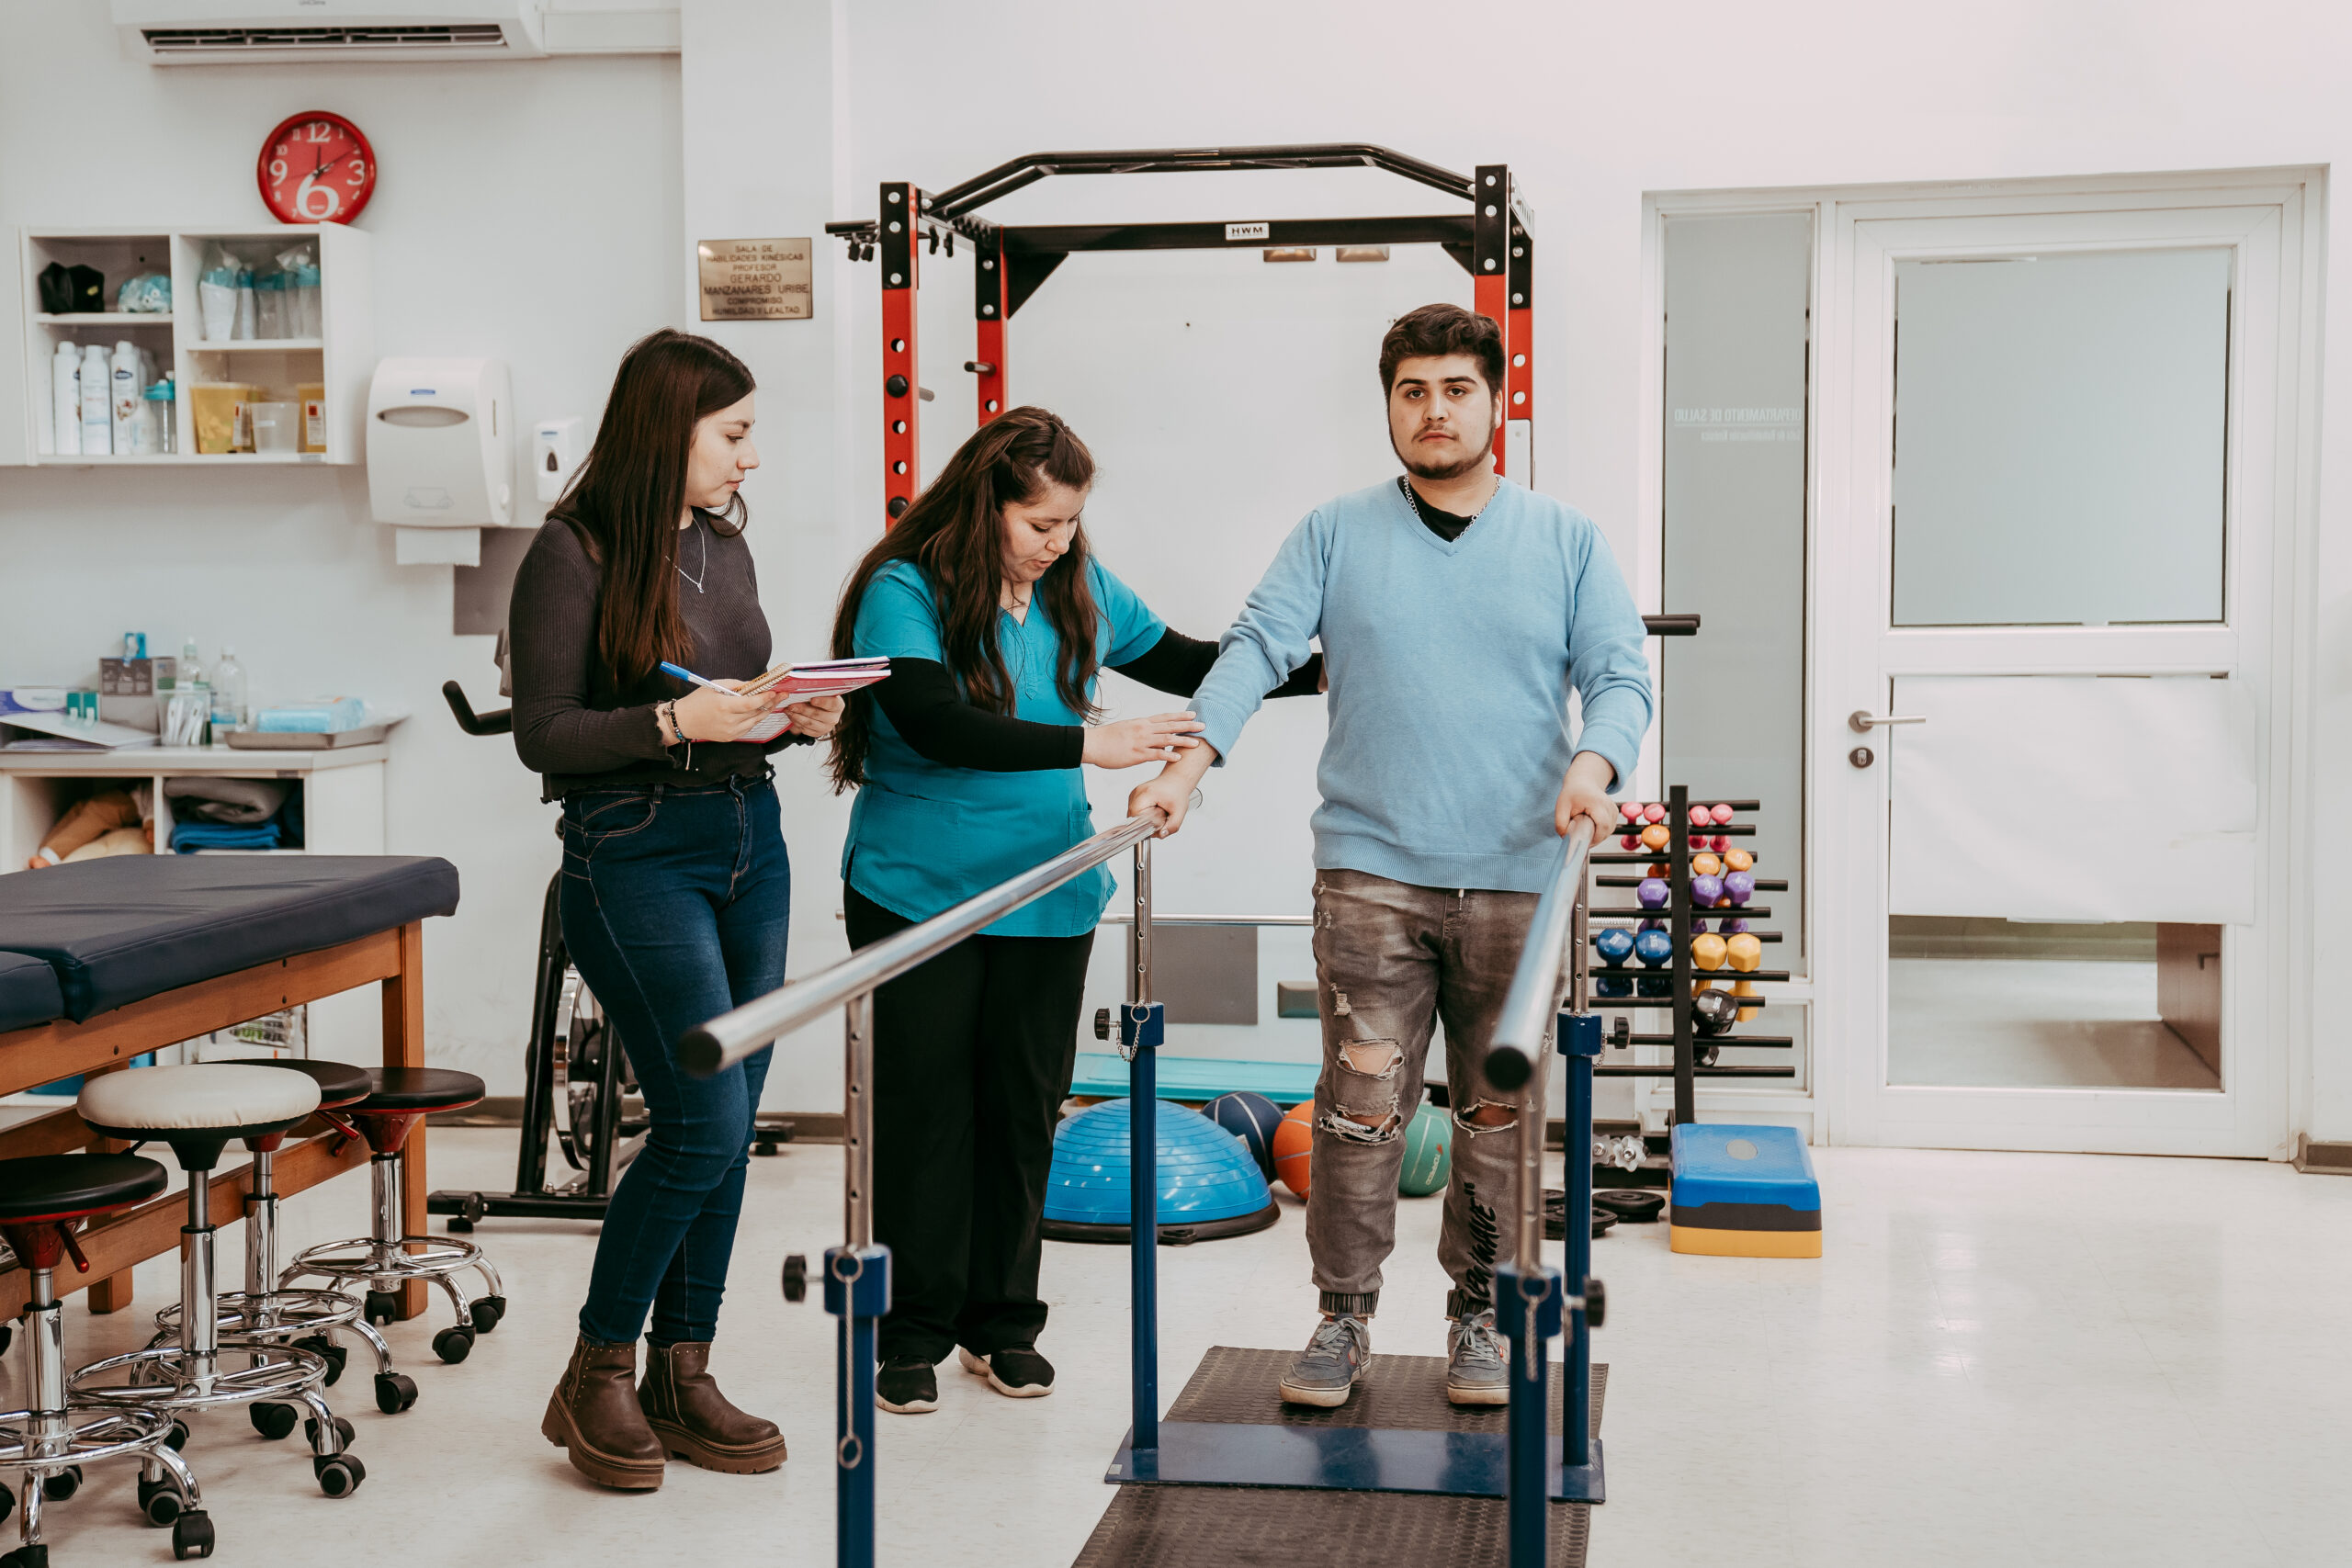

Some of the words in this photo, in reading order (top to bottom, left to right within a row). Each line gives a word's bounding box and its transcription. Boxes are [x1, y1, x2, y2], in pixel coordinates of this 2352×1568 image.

[307, 121, 332, 142] 12
[269, 159, 288, 187] 9
[346, 160, 366, 186] 3
[296, 163, 340, 220] 6
[762, 244, 773, 253] DE
[732, 264, 777, 272] PROFESOR
[730, 274, 782, 284] GERARDO
[704, 285, 772, 296] MANZANARES
[778, 284, 808, 294] URIBE
[712, 307, 755, 316] HUMILDAD
[764, 305, 801, 315] LEALTAD
